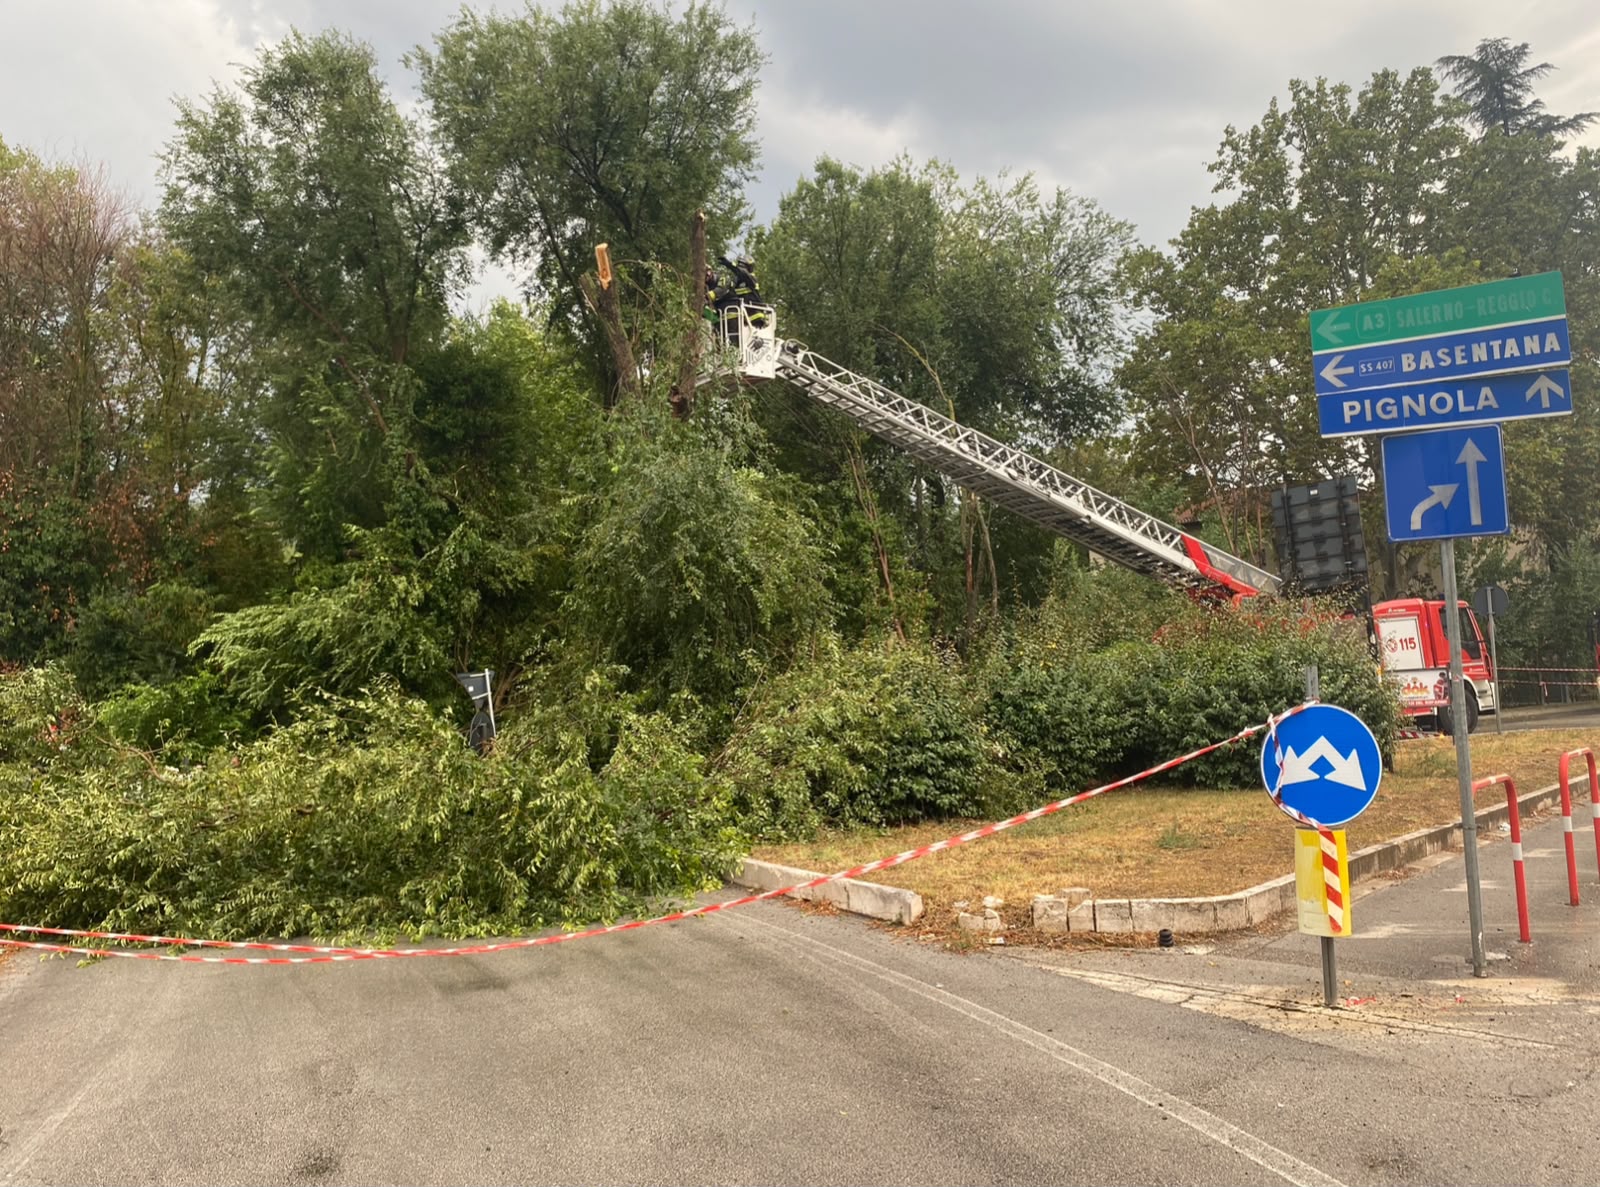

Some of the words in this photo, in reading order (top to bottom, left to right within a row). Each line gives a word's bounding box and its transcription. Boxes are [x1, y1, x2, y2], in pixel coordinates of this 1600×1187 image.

[1362, 312, 1385, 331] A3
[1360, 363, 1374, 373] SS
[1375, 360, 1393, 371] 407
[1401, 332, 1561, 373] BASENTANA
[1342, 386, 1499, 424] PIGNOLA
[1399, 637, 1417, 651] 115
